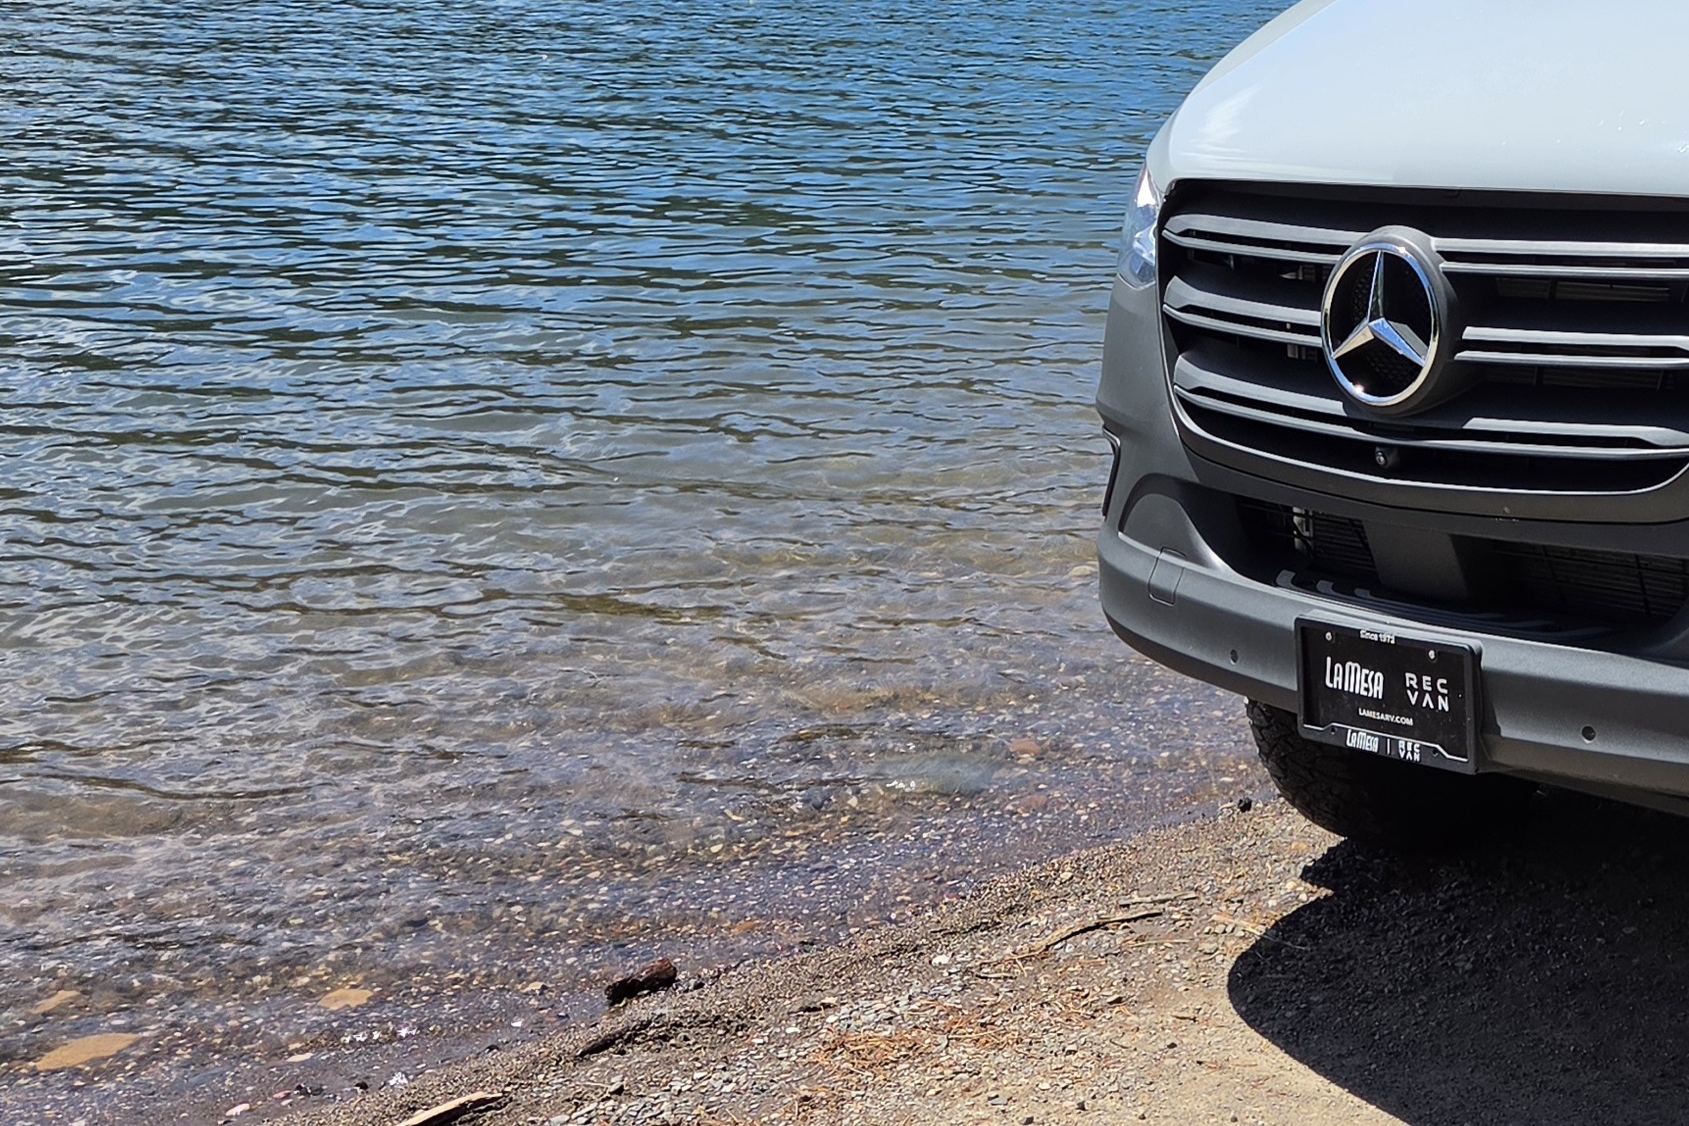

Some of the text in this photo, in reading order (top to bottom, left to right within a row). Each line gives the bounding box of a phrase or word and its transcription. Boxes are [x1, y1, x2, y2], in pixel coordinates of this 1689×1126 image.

[1405, 672, 1449, 694] REC
[1406, 689, 1450, 712] VAN
[1358, 707, 1414, 727] LAMESARV.COM
[1398, 740, 1421, 754] REC
[1399, 748, 1421, 762] VAN
